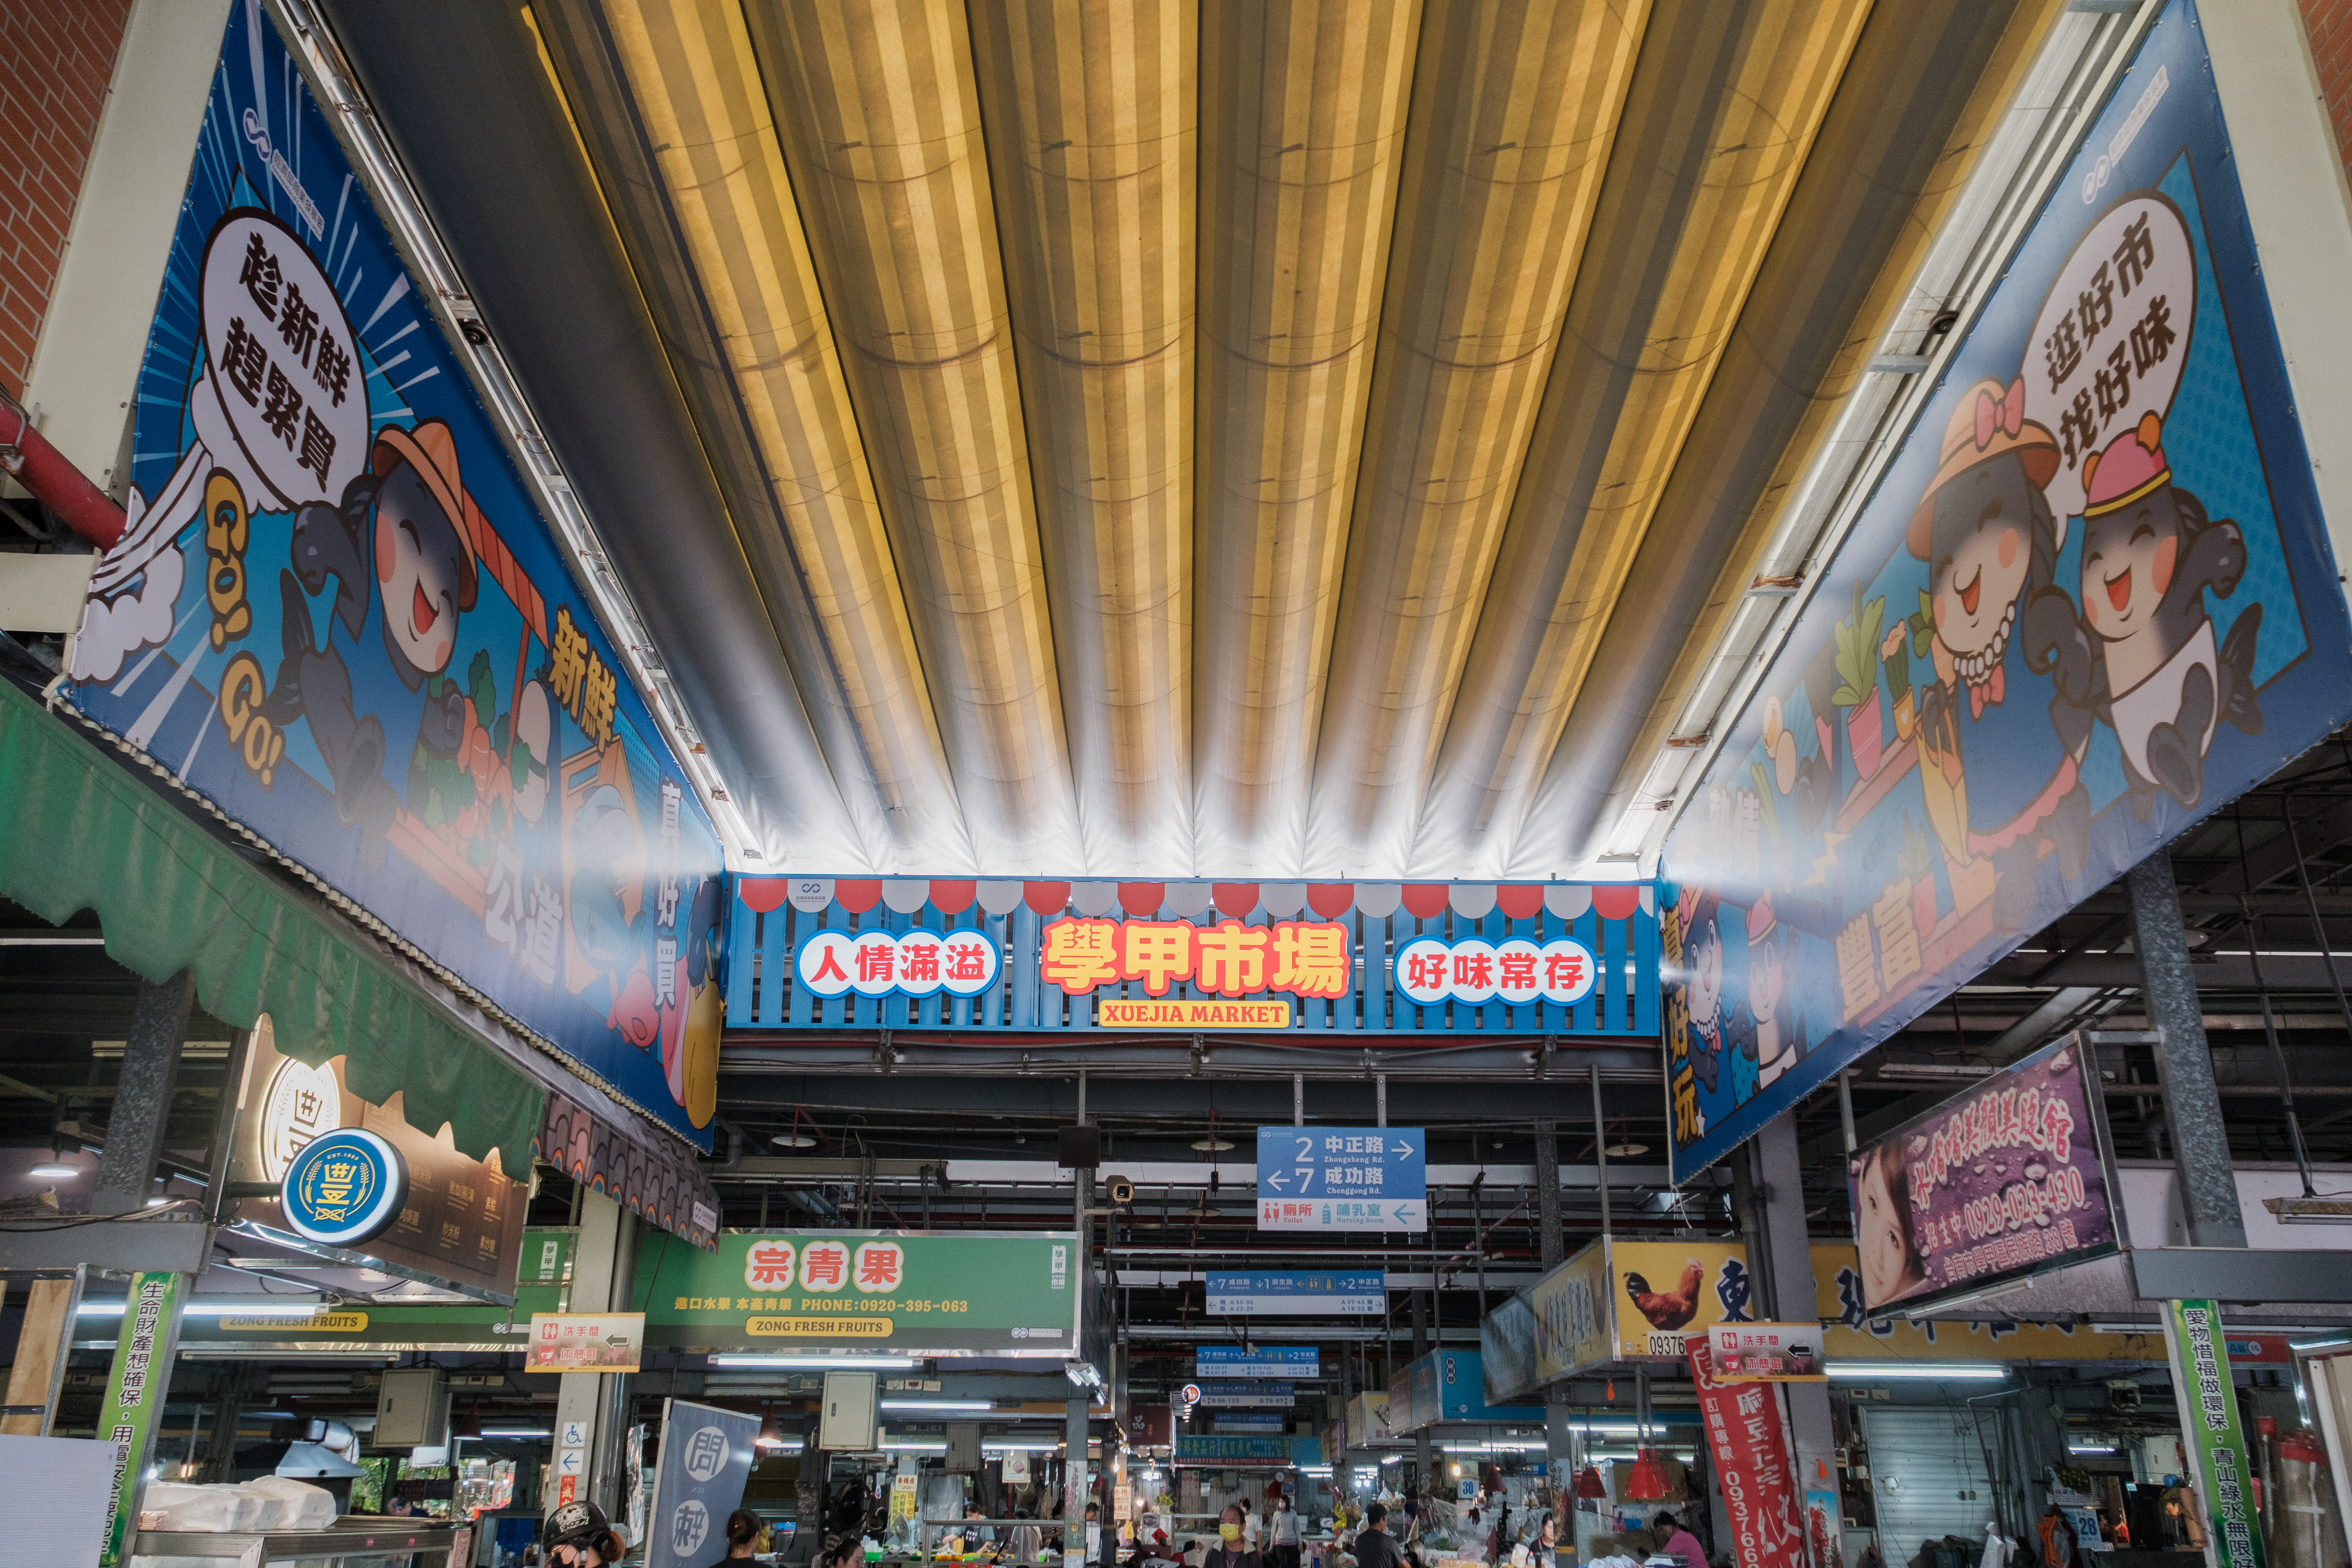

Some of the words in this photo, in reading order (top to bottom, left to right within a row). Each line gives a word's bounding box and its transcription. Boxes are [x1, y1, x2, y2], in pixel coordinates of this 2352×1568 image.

[2045, 211, 2154, 394] 逛好市
[239, 231, 350, 407] 趁新鮮
[2059, 295, 2176, 470] 找好味
[220, 316, 337, 493] 趕緊買
[549, 608, 617, 754] 新鮮
[485, 844, 564, 986] 公道
[1048, 923, 1344, 992] 學甲市場
[1836, 876, 1922, 1021] 豐富
[813, 945, 985, 982] 人情滿溢
[1410, 953, 1583, 989] 好味常存
[1106, 1006, 1183, 1021] XUEJIA
[1191, 1007, 1283, 1022] MARKET
[1663, 905, 1698, 1144] 真好玩
[1295, 1138, 1314, 1162] 2
[1325, 1136, 1384, 1154] 中正路
[1295, 1168, 1314, 1193] 7
[1325, 1167, 1383, 1185] 成功路
[1283, 1204, 1312, 1217] 廁所
[1337, 1203, 1381, 1216] 哺乳室
[1964, 1167, 2085, 1239] 0929-023-430
[1925, 1209, 1963, 1253] 招生中
[752, 1248, 899, 1285] 宗青果
[1218, 1279, 1226, 1289] 7
[1264, 1279, 1269, 1289] 1
[1348, 1279, 1356, 1289] 2
[675, 1297, 730, 1310] 進口水果
[736, 1298, 792, 1311] 本產青果
[801, 1298, 968, 1312] PHONE:0920-395-063
[229, 1316, 261, 1326] ZONG
[263, 1316, 308, 1327] FRESH
[312, 1317, 358, 1328] FRUITS
[564, 1326, 599, 1337] 洗手間
[756, 1321, 791, 1332] ZONG
[794, 1321, 835, 1332] FRESH
[838, 1321, 883, 1332] FRUITS
[1743, 1335, 1779, 1346] 洗手間
[560, 1348, 598, 1360] 休憩區
[1746, 1357, 1783, 1369] 休憩區
[1375, 1430, 1392, 1438] 素食
[1463, 1481, 1473, 1494] 30
[2079, 1517, 2097, 1536] 28
